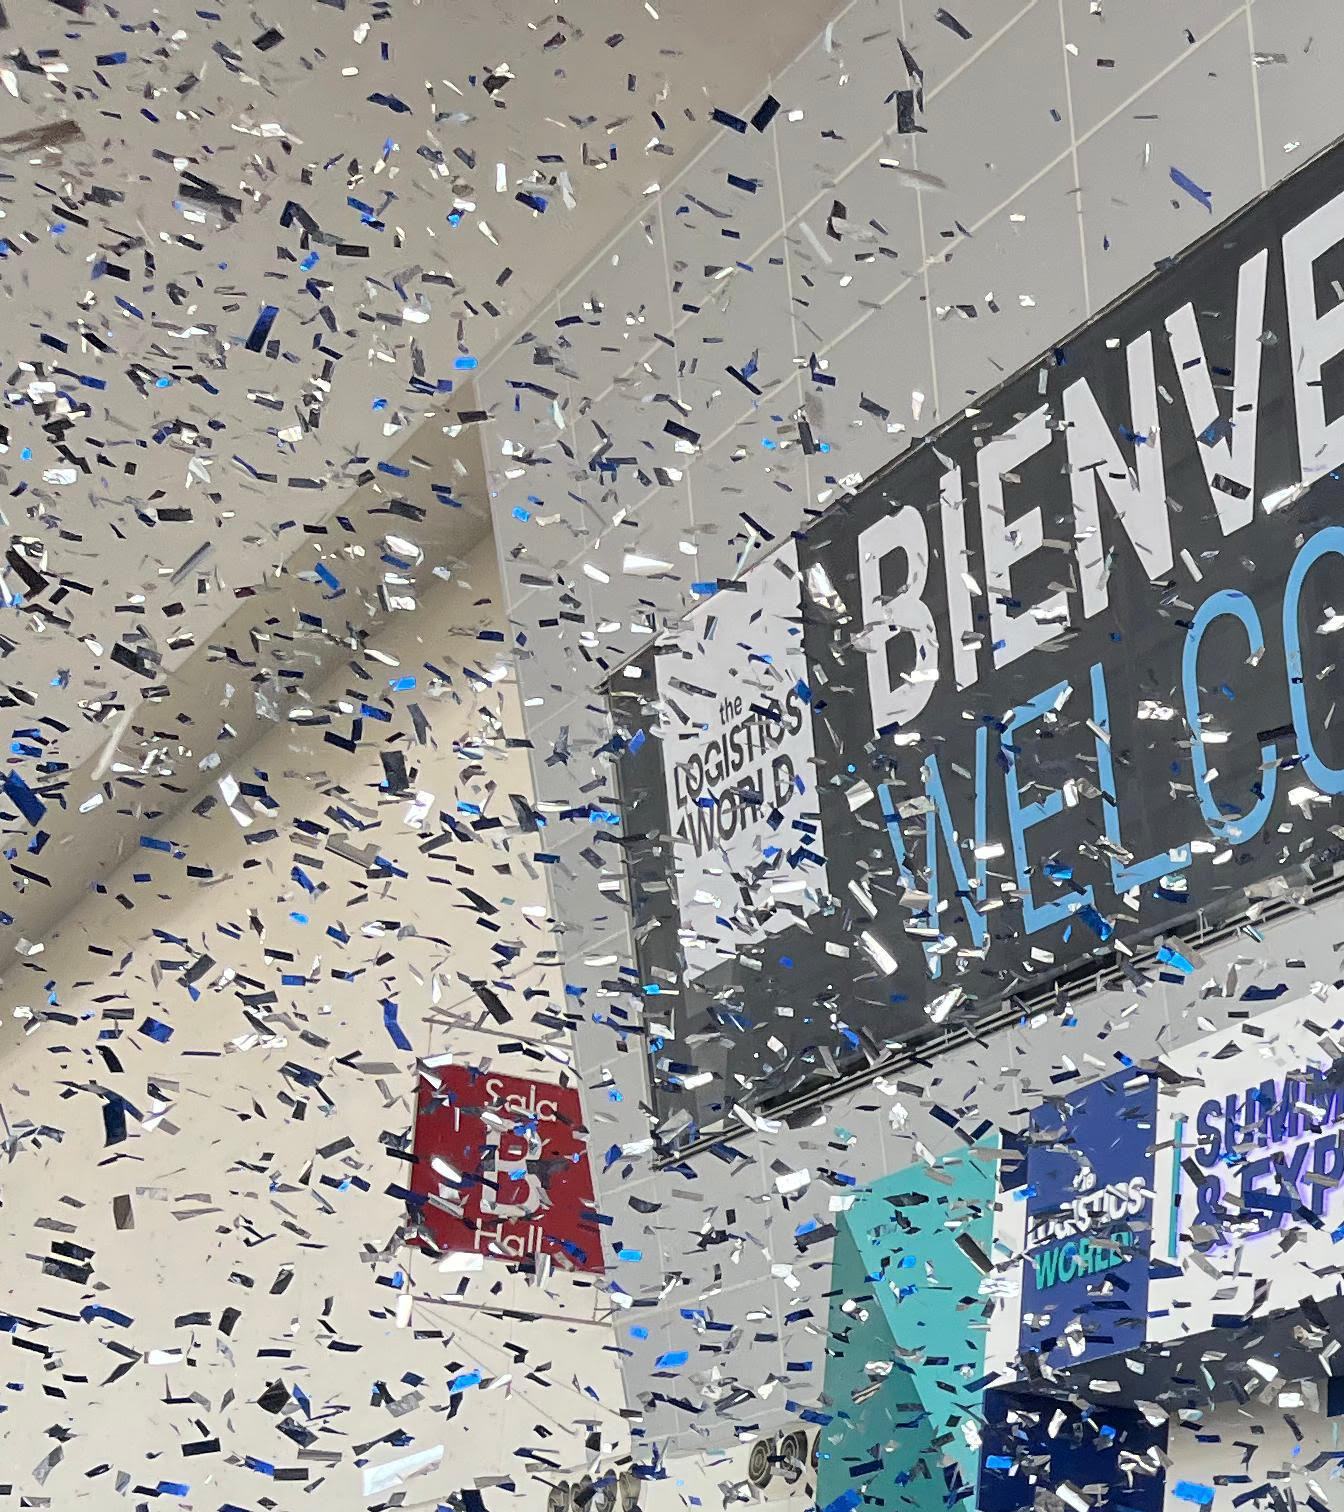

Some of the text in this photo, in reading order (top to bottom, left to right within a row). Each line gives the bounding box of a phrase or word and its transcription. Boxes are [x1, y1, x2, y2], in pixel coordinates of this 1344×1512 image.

[719, 695, 743, 725] the
[485, 1079, 558, 1122] Sala
[480, 1122, 544, 1216] B
[474, 1217, 544, 1257] Hall
